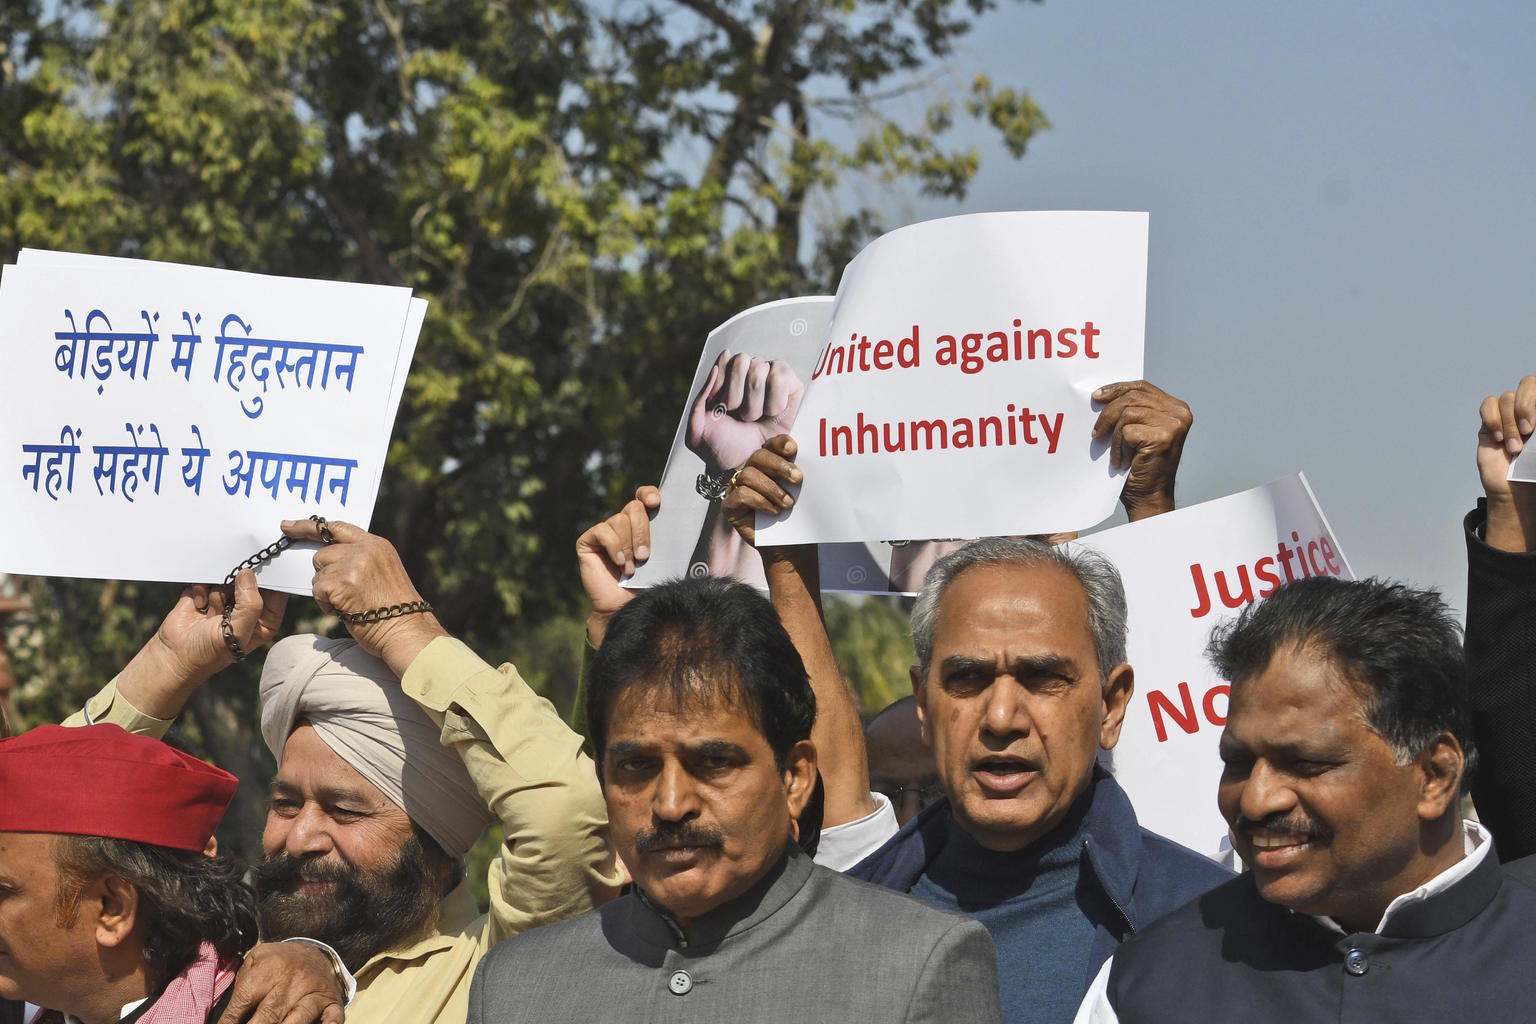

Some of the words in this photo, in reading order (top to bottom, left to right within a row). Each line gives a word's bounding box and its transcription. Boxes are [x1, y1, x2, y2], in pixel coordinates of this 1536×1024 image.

[54, 308, 159, 394] बेड़ियों
[170, 311, 202, 381] में
[213, 313, 365, 420] हिंदुस्तान
[811, 325, 921, 381] United
[935, 318, 1101, 375] against
[21, 425, 81, 500] नहीं
[92, 423, 169, 502] सहेंगे
[181, 424, 212, 497] ये
[221, 449, 359, 507] अपमान
[819, 403, 1065, 458] Inhumanity
[1190, 531, 1341, 618] Justice
